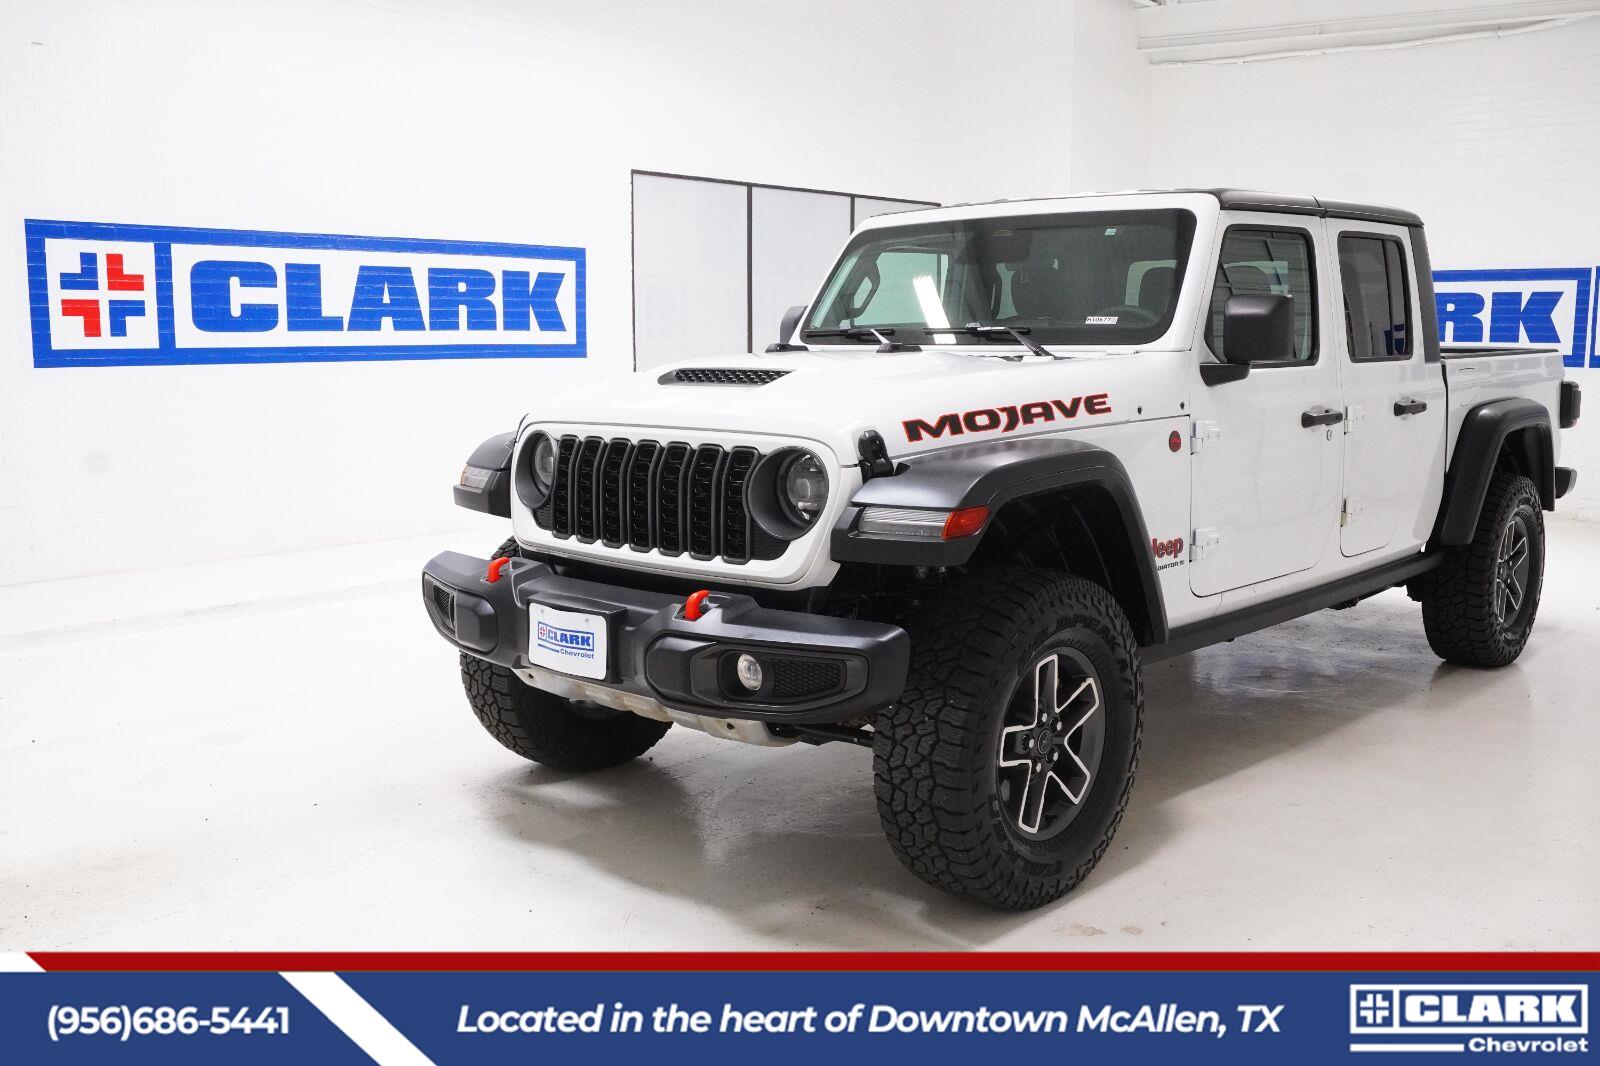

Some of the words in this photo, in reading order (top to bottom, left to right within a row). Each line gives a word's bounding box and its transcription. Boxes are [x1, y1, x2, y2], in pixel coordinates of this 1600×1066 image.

[189, 259, 567, 332] CLARK
[902, 393, 1112, 443] MOJAVE
[1157, 561, 1179, 571] DIATOR
[547, 628, 591, 647] CLARK
[560, 648, 595, 660] Chevrolet
